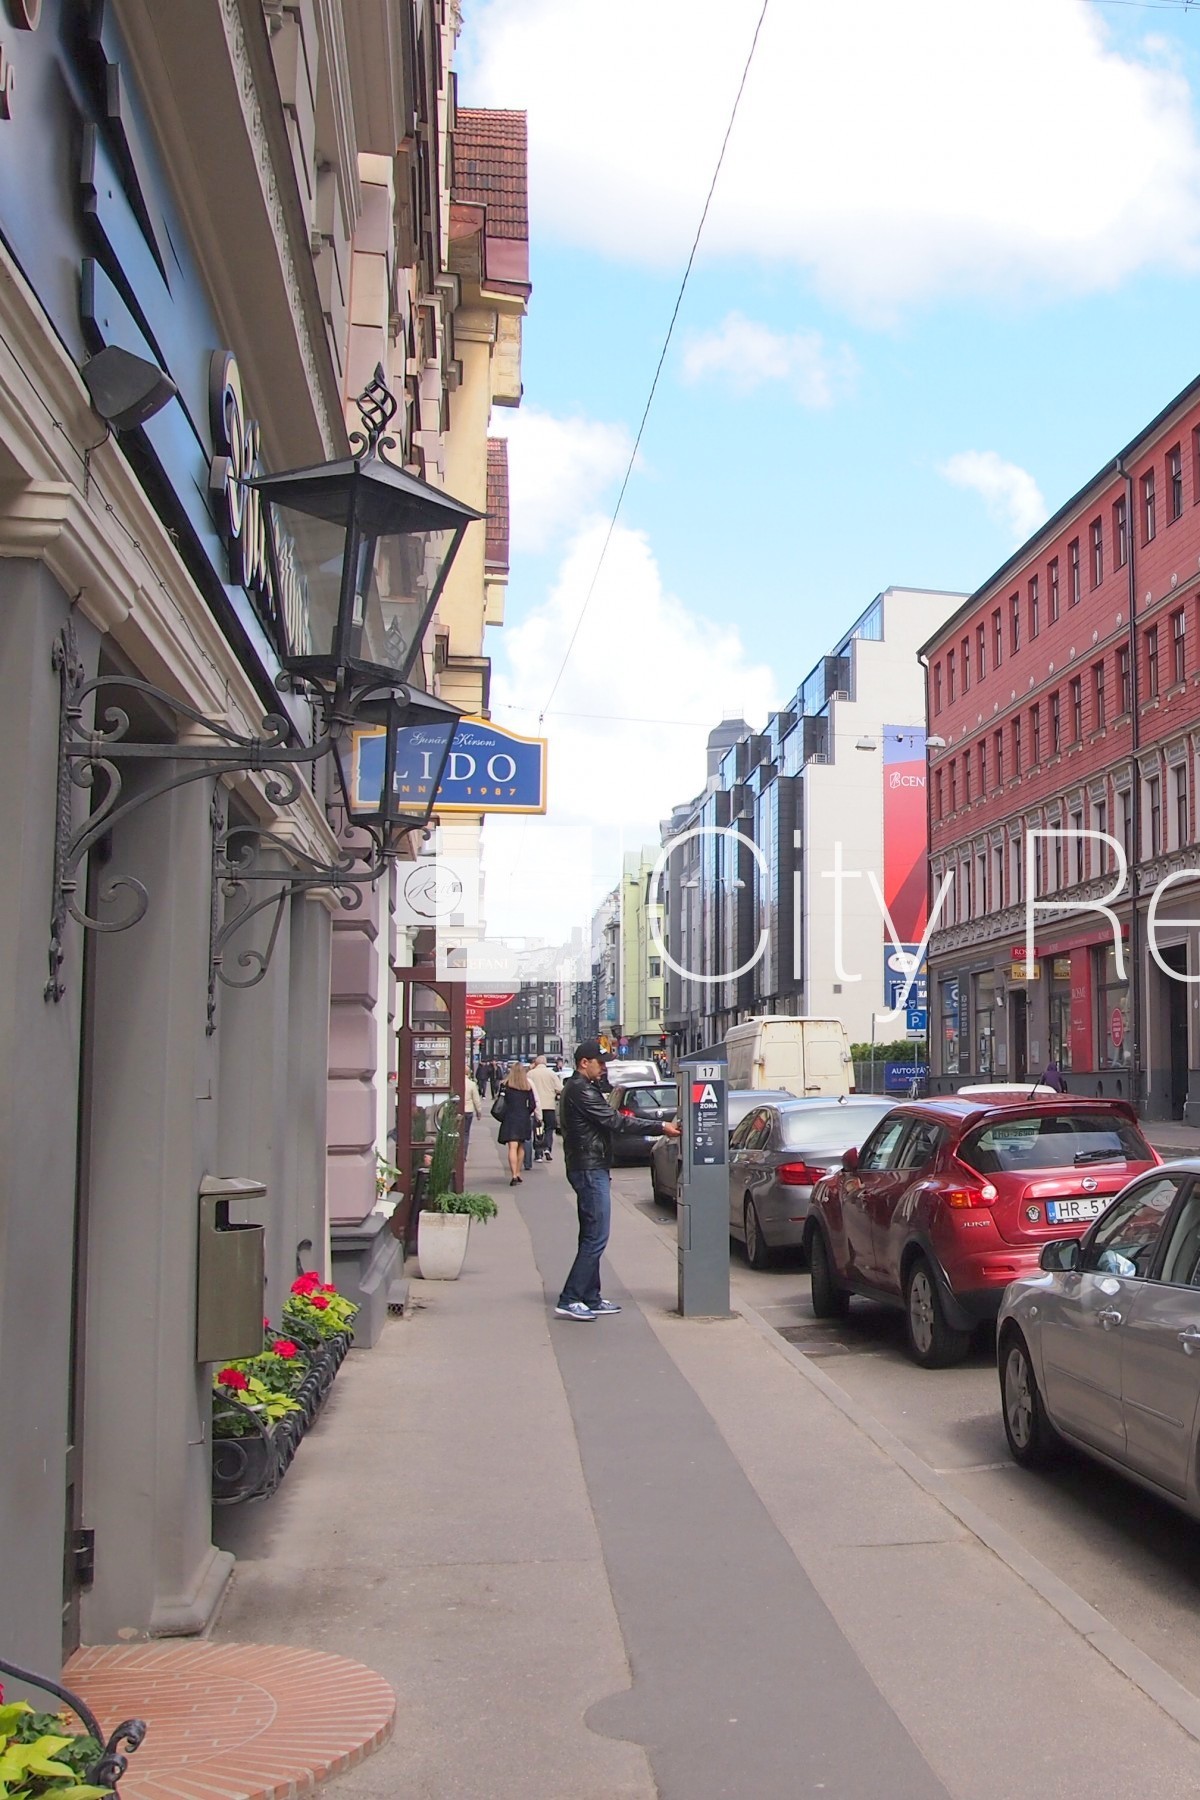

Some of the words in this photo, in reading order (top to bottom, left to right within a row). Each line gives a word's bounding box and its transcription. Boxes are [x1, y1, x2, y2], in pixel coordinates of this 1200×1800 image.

[409, 731, 448, 746] Gunār
[901, 775, 927, 787] CEN
[466, 787, 517, 796] 1987
[702, 1067, 714, 1077] 17
[700, 1084, 718, 1102] A
[1058, 1199, 1113, 1217] HR-51
[961, 1220, 991, 1228] JUKE
